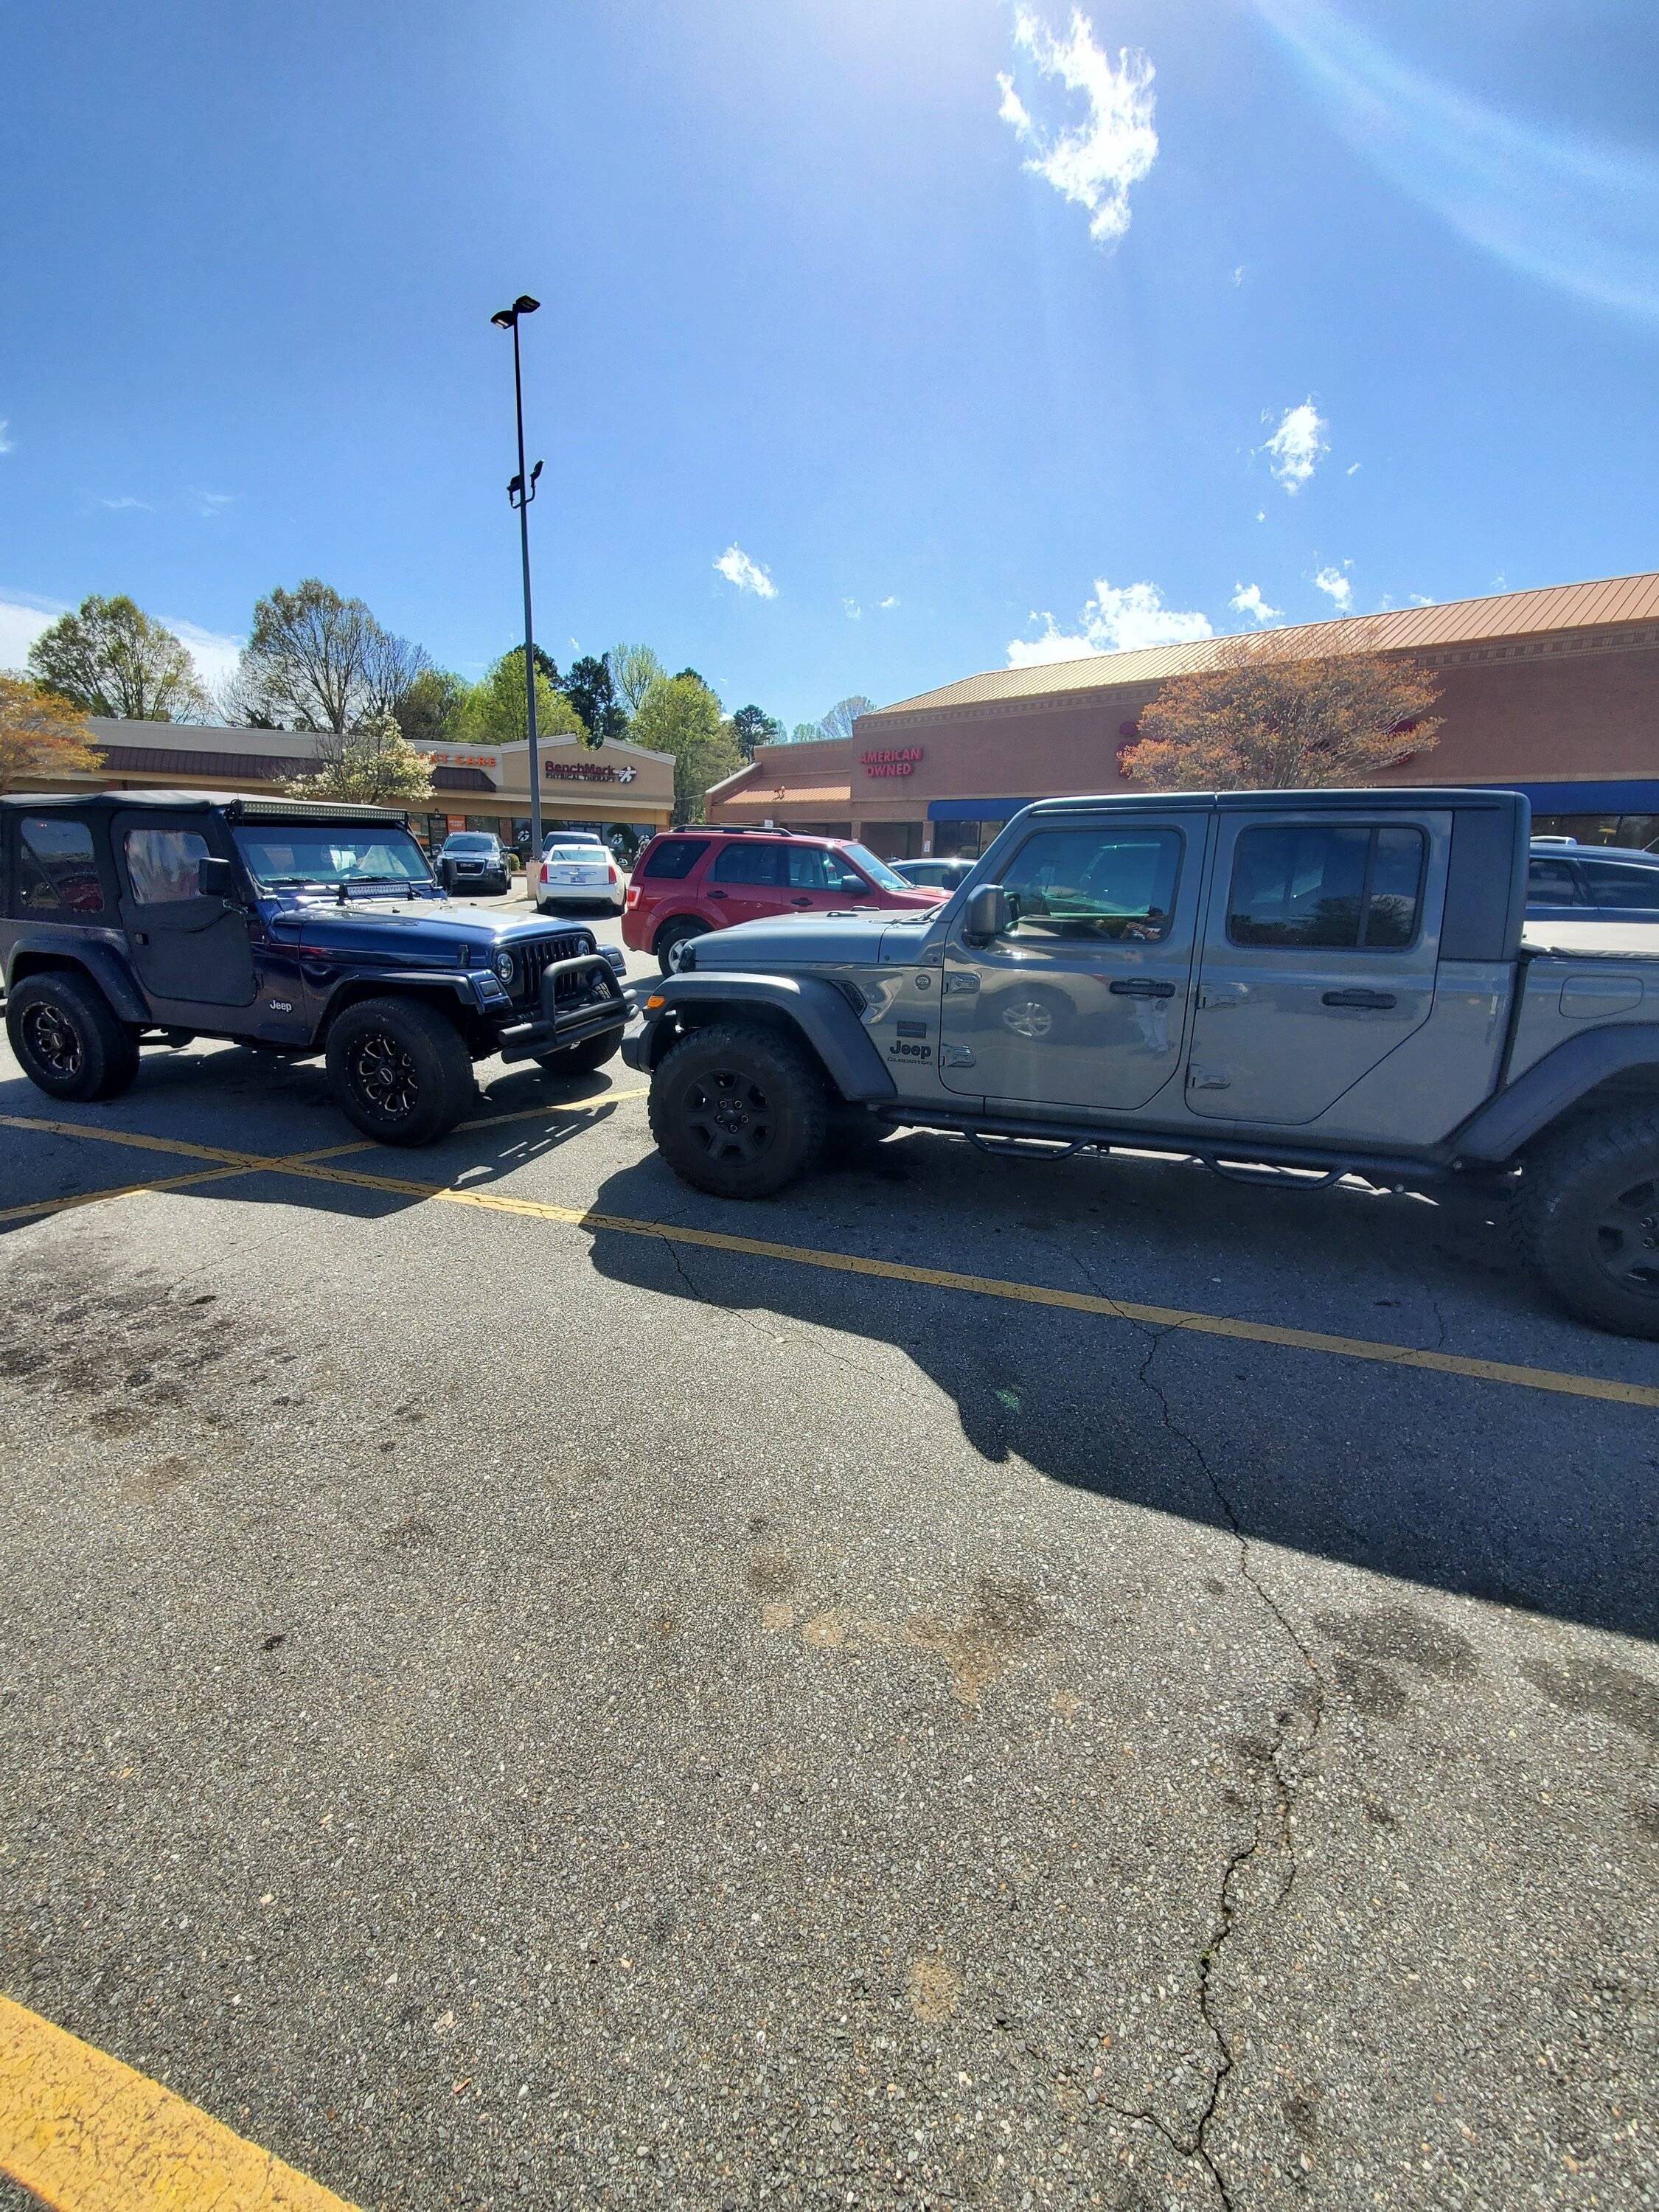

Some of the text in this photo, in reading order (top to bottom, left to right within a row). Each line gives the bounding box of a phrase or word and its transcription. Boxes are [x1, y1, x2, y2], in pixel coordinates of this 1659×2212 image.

[456, 754, 496, 768] CARE
[860, 747, 923, 763] AMERICAN
[546, 760, 615, 776] BenchMark
[866, 762, 914, 777] OWNED
[269, 999, 292, 1012] Jeep
[889, 1040, 932, 1060] Jeep
